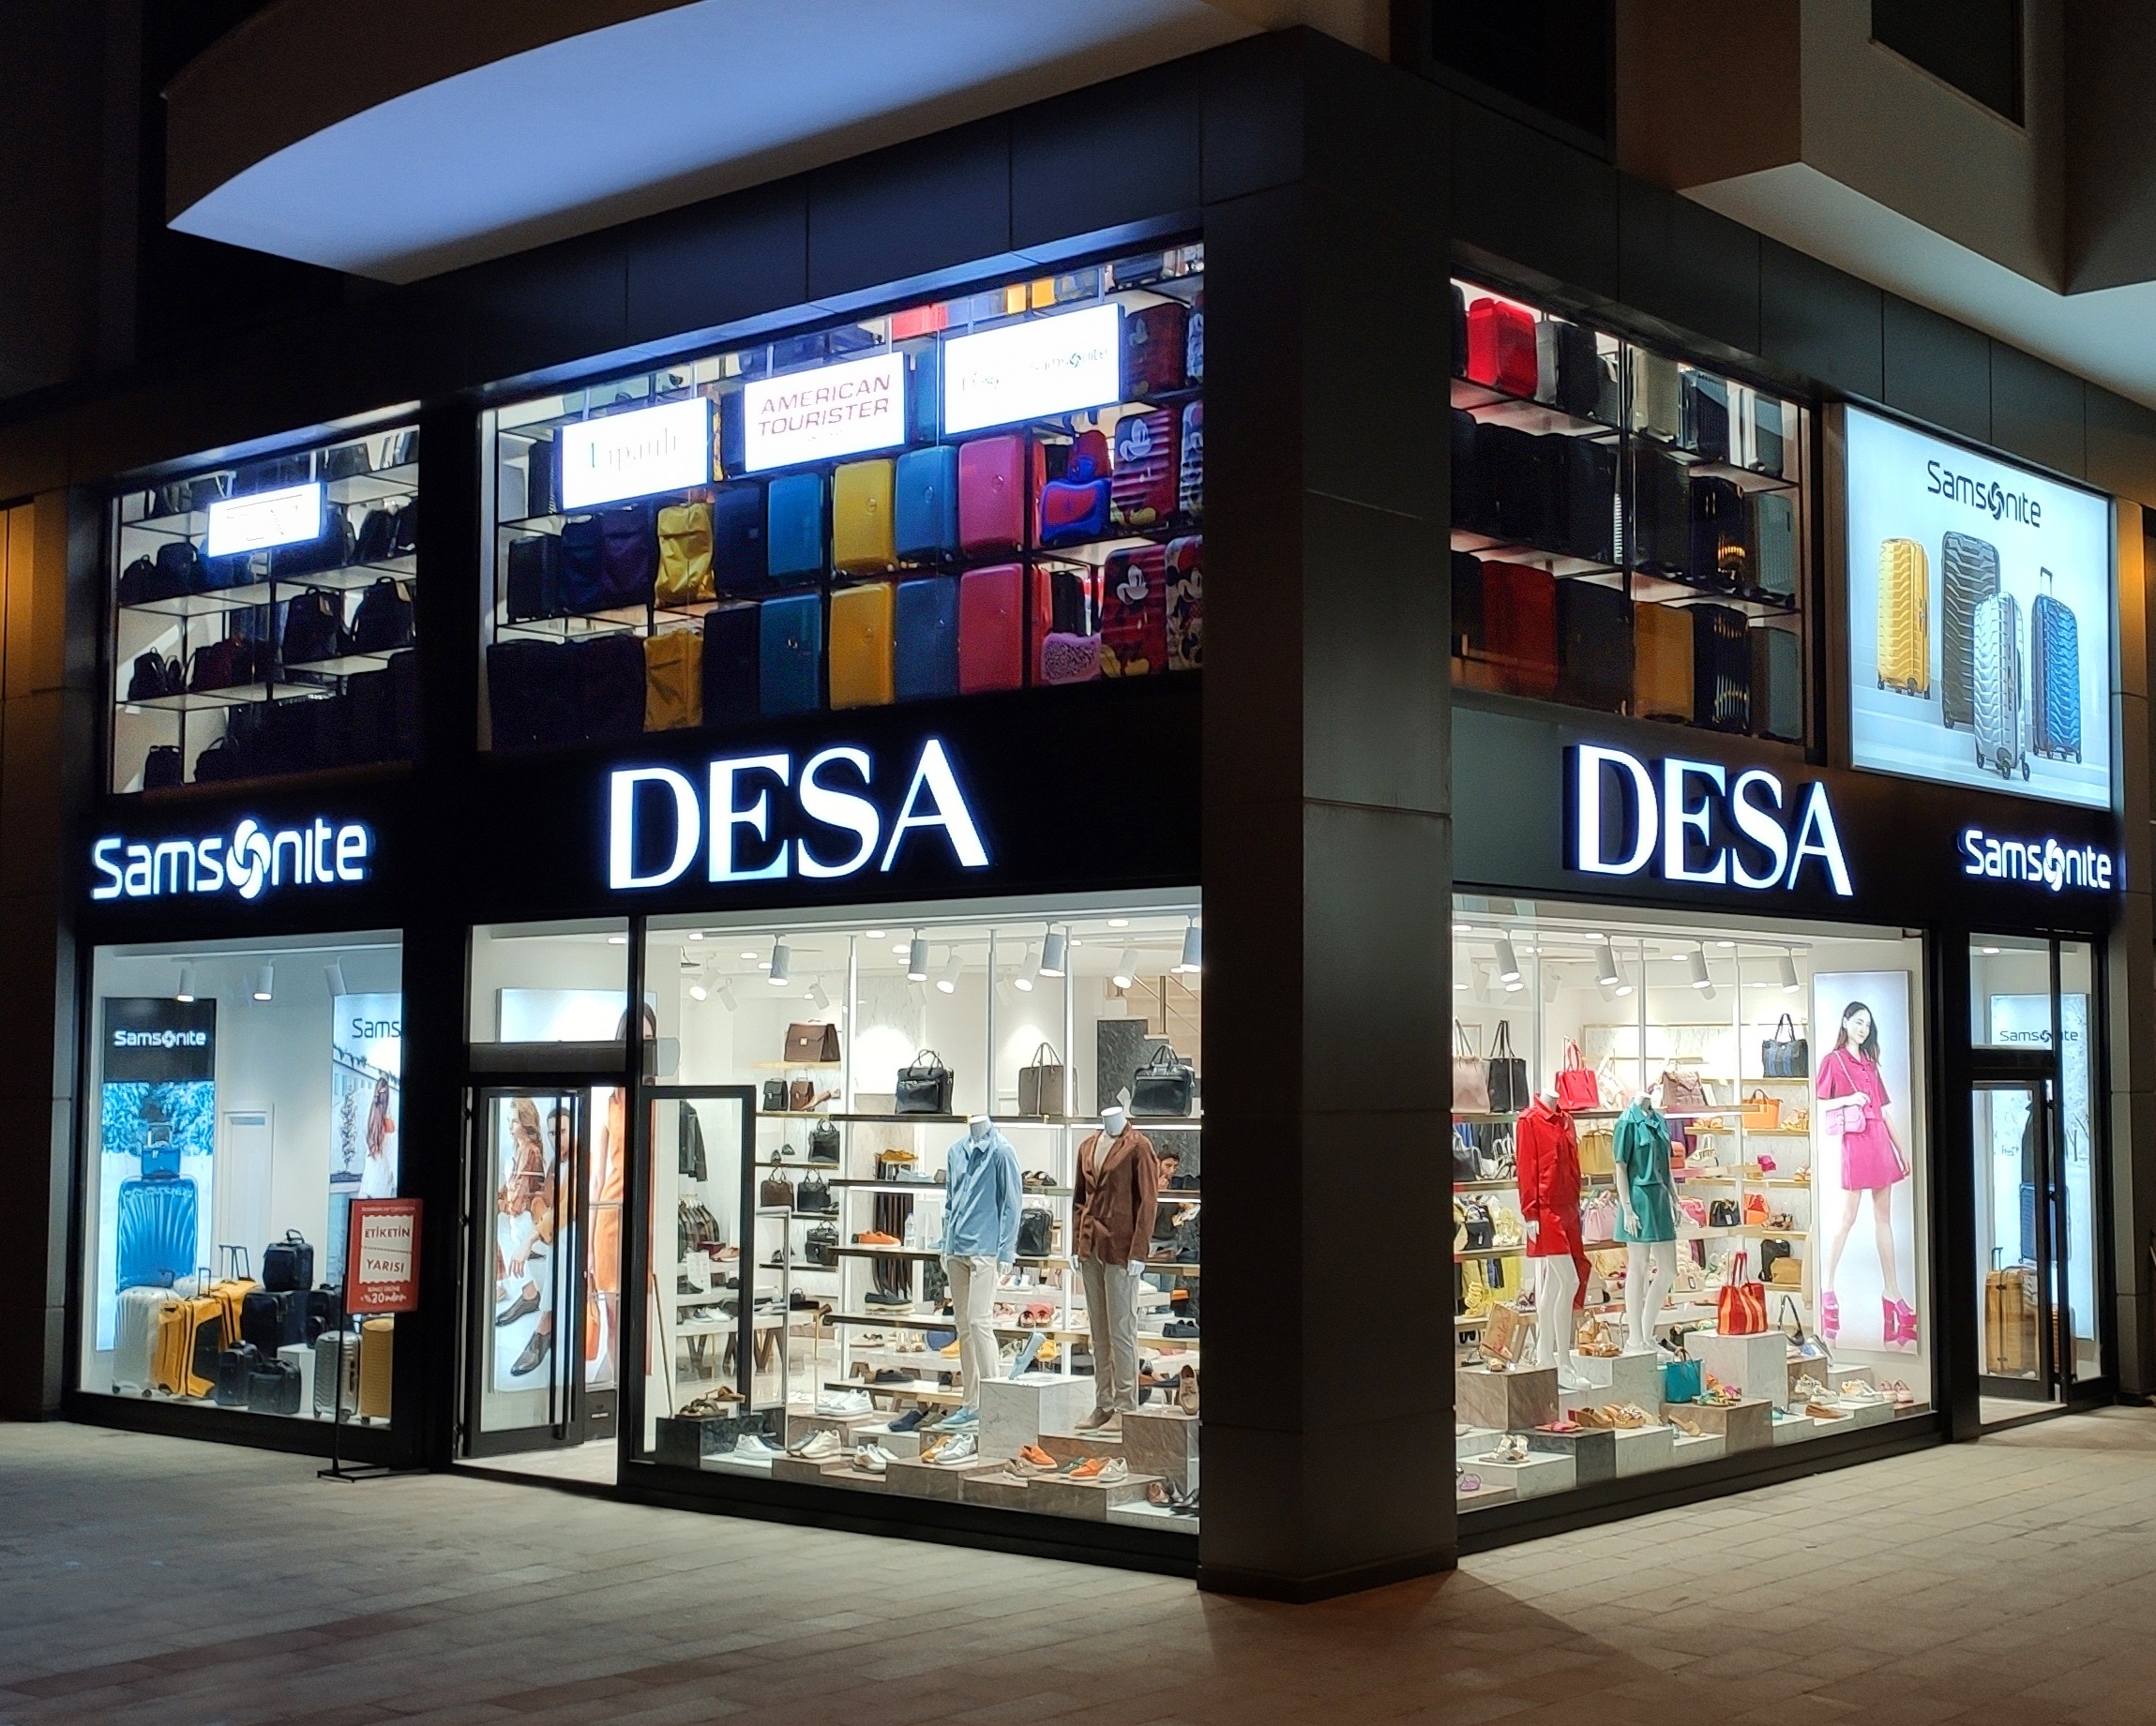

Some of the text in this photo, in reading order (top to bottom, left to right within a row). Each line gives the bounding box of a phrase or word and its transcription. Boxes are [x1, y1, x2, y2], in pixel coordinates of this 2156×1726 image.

[761, 374, 891, 414] AMERICAN
[758, 398, 889, 436] TOURISTER
[1926, 459, 2043, 528] Samsonite
[610, 739, 988, 890] DESA
[1577, 743, 1854, 897] DESA
[91, 818, 369, 899] Samsonite
[1964, 828, 2112, 893] Samsonite
[113, 1029, 207, 1048] Samsonite
[1999, 1029, 2079, 1043] Samsote
[365, 1225, 411, 1238] ETİKETİN
[366, 1258, 405, 1273] YARISI
